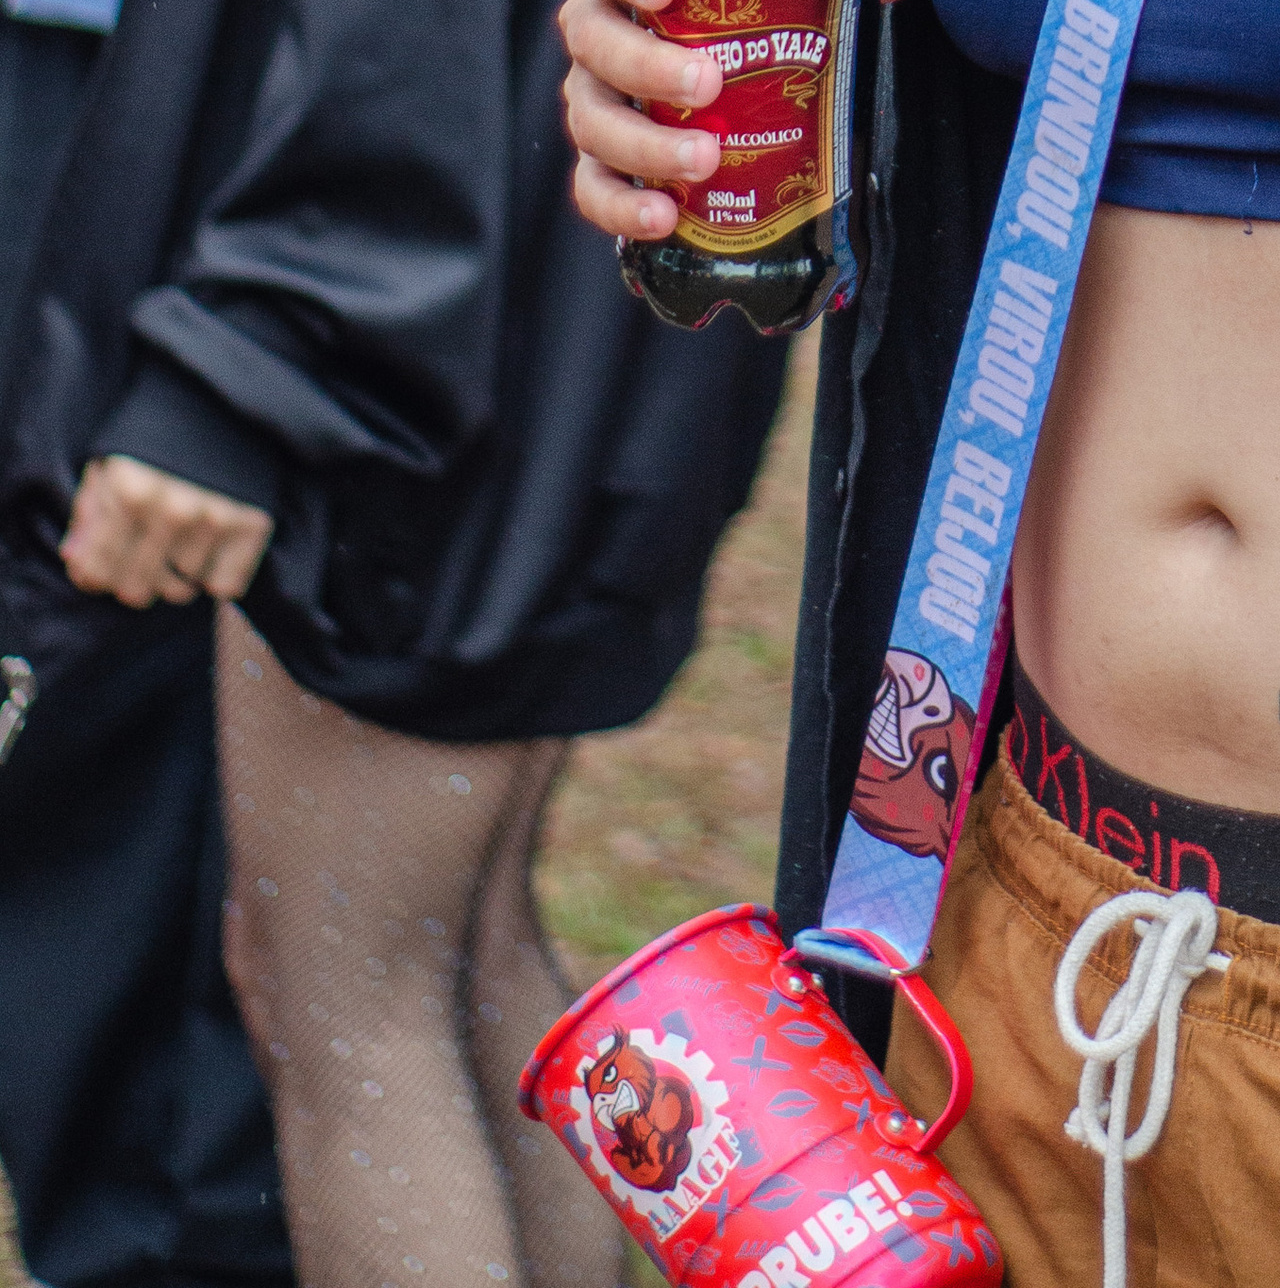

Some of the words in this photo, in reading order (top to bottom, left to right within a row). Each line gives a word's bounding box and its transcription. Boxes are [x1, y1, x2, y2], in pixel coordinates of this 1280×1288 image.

[746, 38, 769, 61] DO
[771, 31, 828, 65] VALE
[724, 127, 803, 147] ALCOÓLICO
[707, 189, 757, 208] 880ml
[709, 211, 733, 223] 11%
[957, 258, 1059, 438] VIROU,
[918, 440, 1012, 644] BEIJOU
